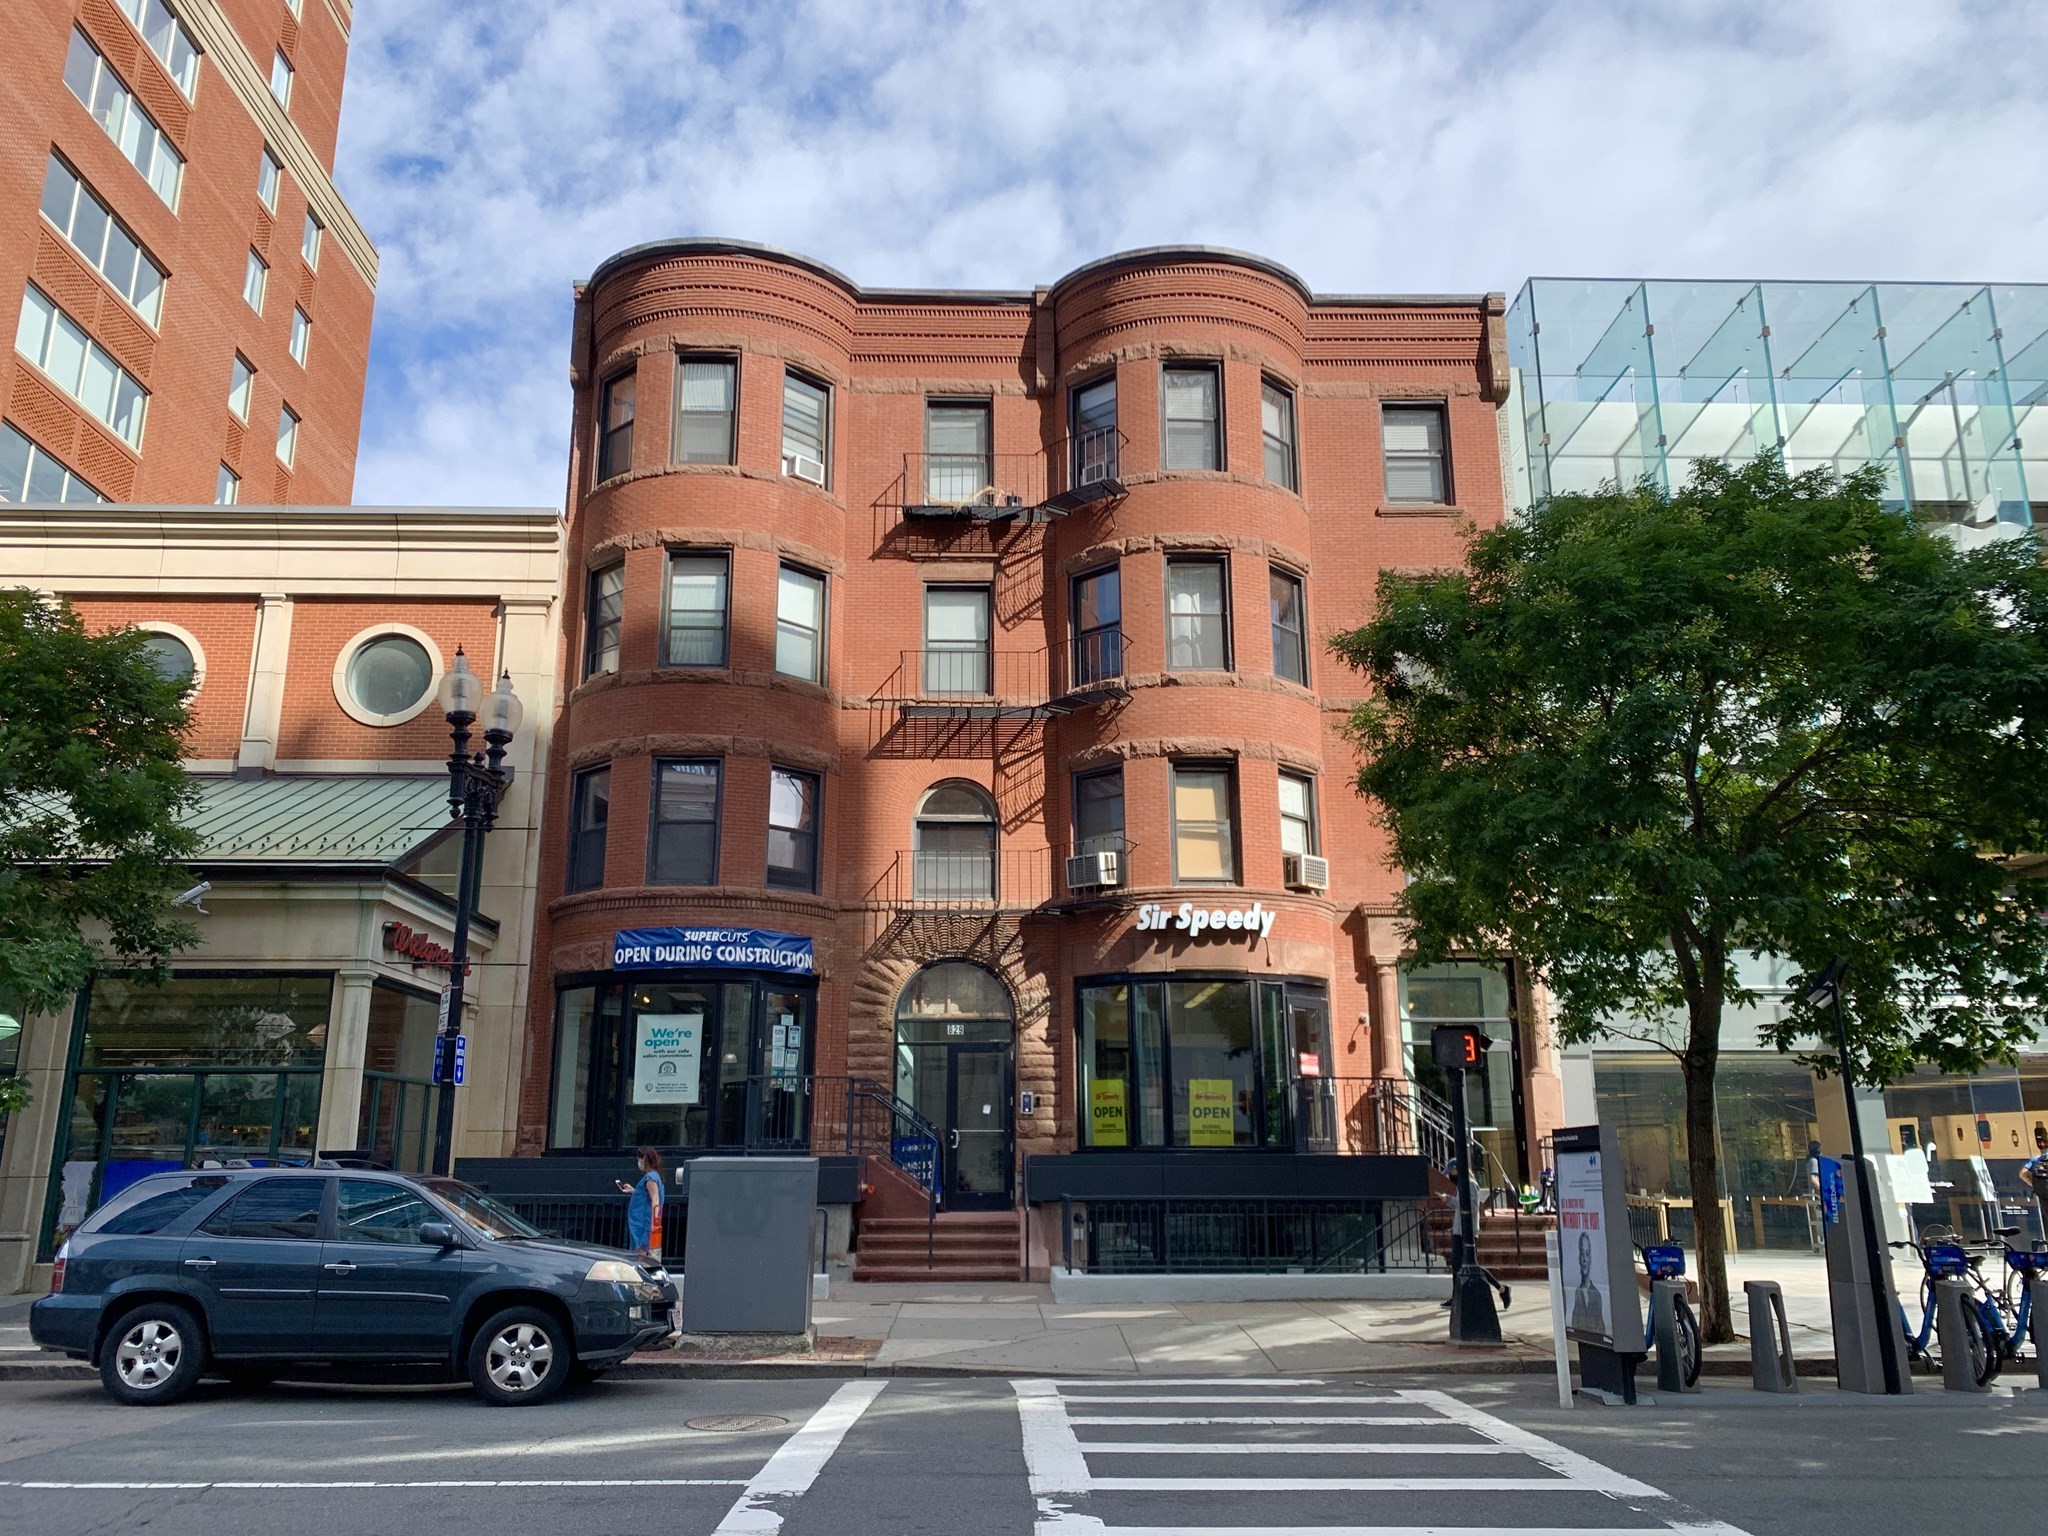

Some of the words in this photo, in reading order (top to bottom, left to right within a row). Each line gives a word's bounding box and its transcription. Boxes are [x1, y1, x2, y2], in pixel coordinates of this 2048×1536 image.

[1136, 904, 1172, 931] Sir
[1175, 902, 1276, 938] Speedy
[683, 931, 749, 943] SUPERCUTS
[614, 946, 651, 965] OPEN
[655, 944, 713, 962] DURING
[716, 945, 813, 970] CONSTRUCTION
[651, 1028, 693, 1038] We're
[947, 1024, 964, 1035] 829
[644, 1039, 680, 1050] open
[1463, 1035, 1476, 1062] 3
[1094, 1106, 1123, 1118] OPEN
[1192, 1106, 1231, 1119] OPEN
